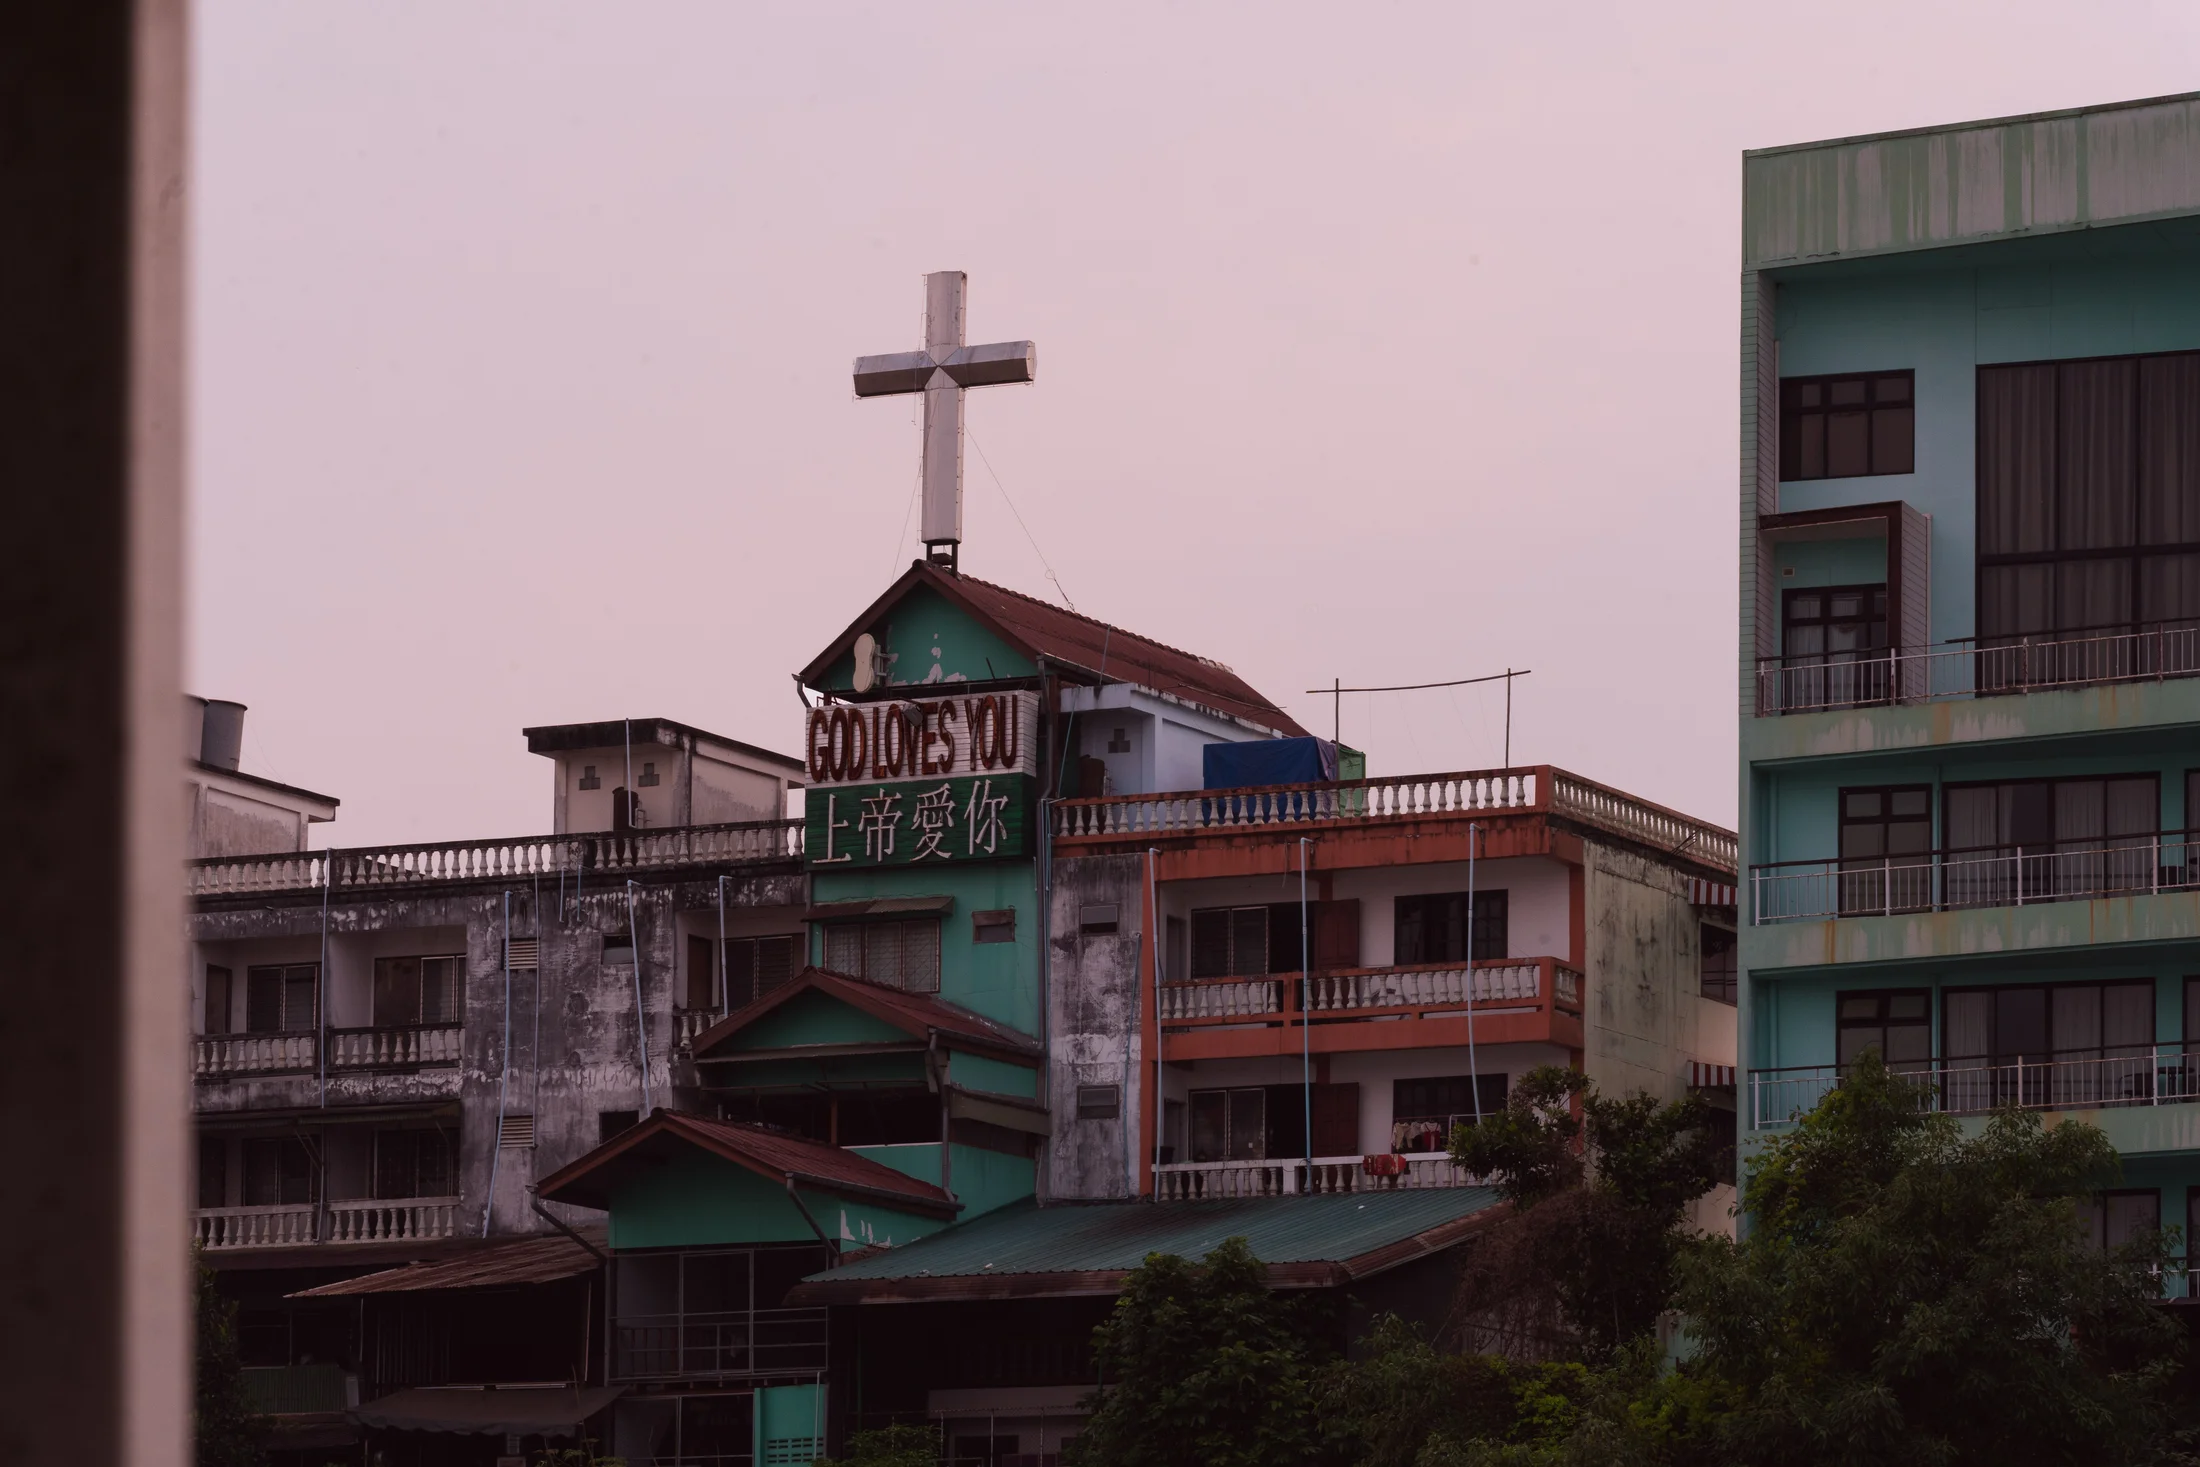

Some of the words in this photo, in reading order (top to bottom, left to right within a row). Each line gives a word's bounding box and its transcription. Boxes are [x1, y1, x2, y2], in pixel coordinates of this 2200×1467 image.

[809, 708, 866, 783] GOD
[872, 699, 957, 779] LOVES
[963, 694, 1018, 771] YOU
[812, 779, 1009, 863] 上帝愛你
